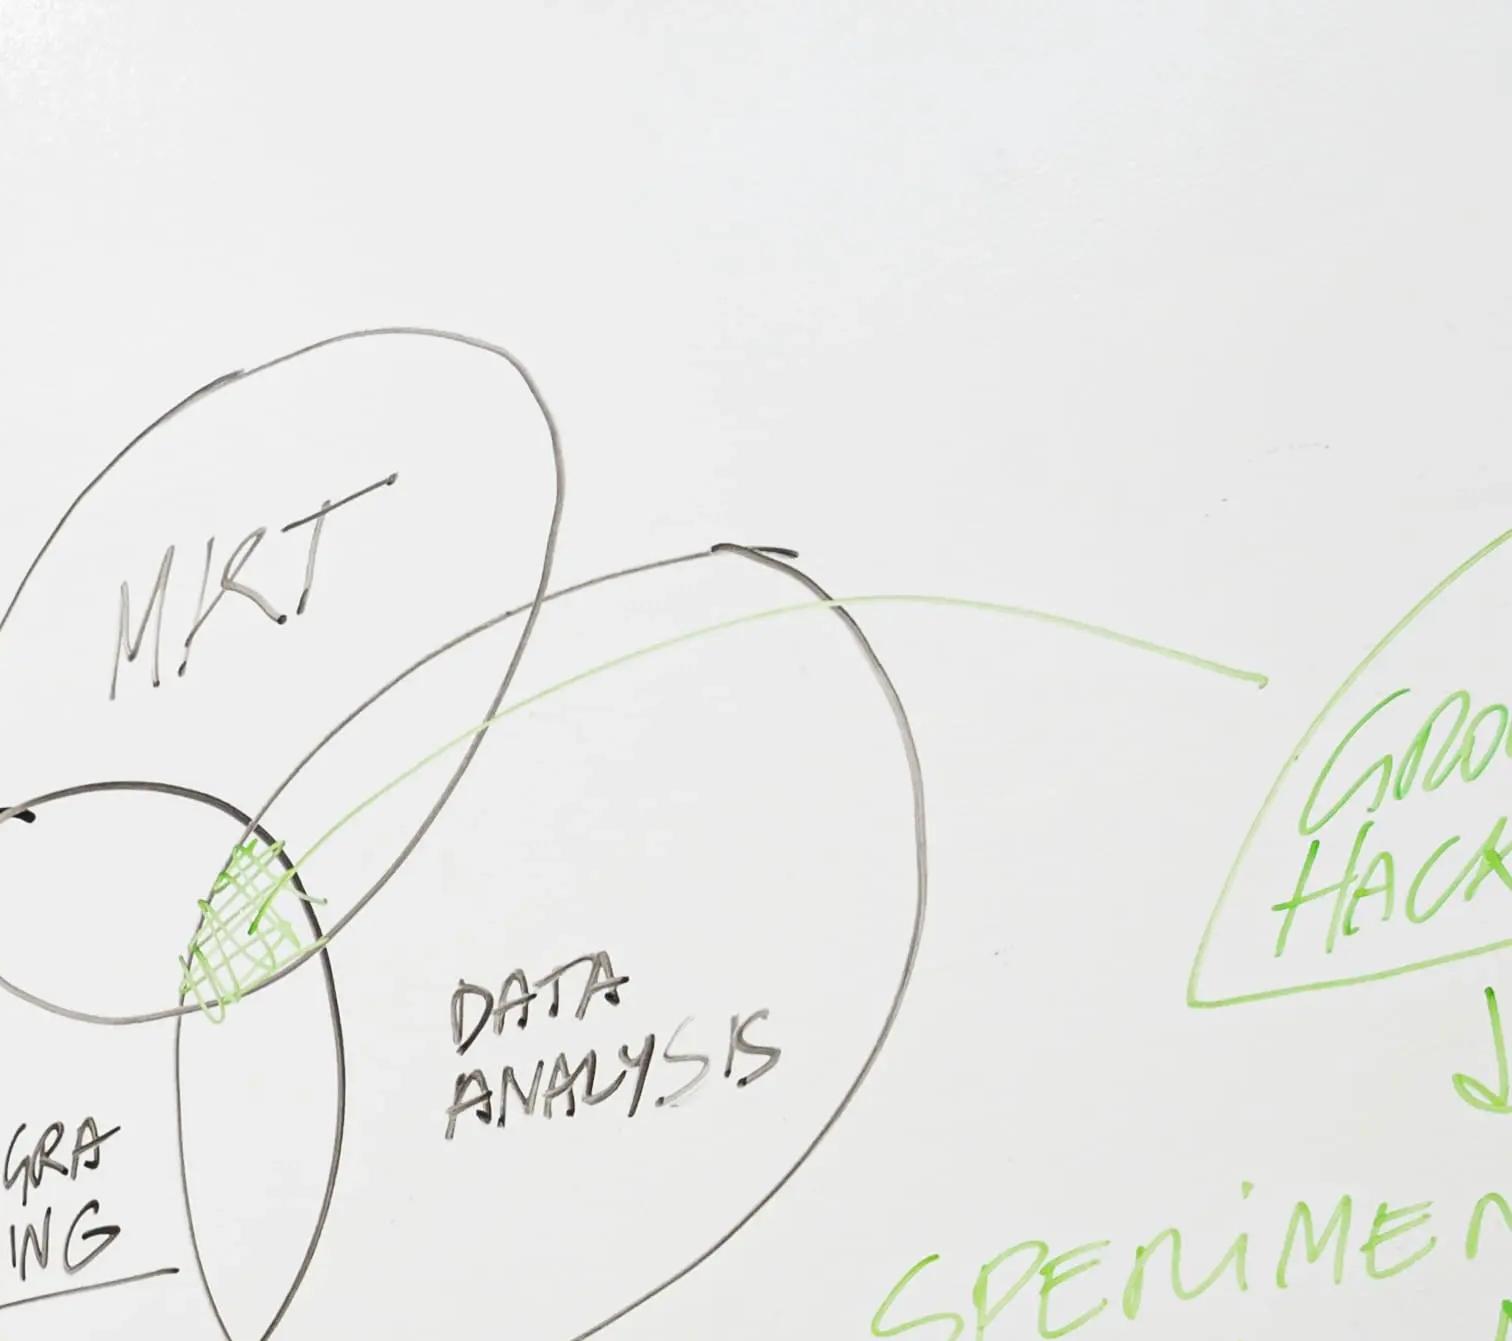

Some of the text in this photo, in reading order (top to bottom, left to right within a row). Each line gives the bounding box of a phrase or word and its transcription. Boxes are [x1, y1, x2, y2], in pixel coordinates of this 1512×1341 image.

[1299, 688, 1512, 836] GRO
[450, 951, 629, 1056] DATA
[443, 1009, 783, 1140] ANALYSIS
